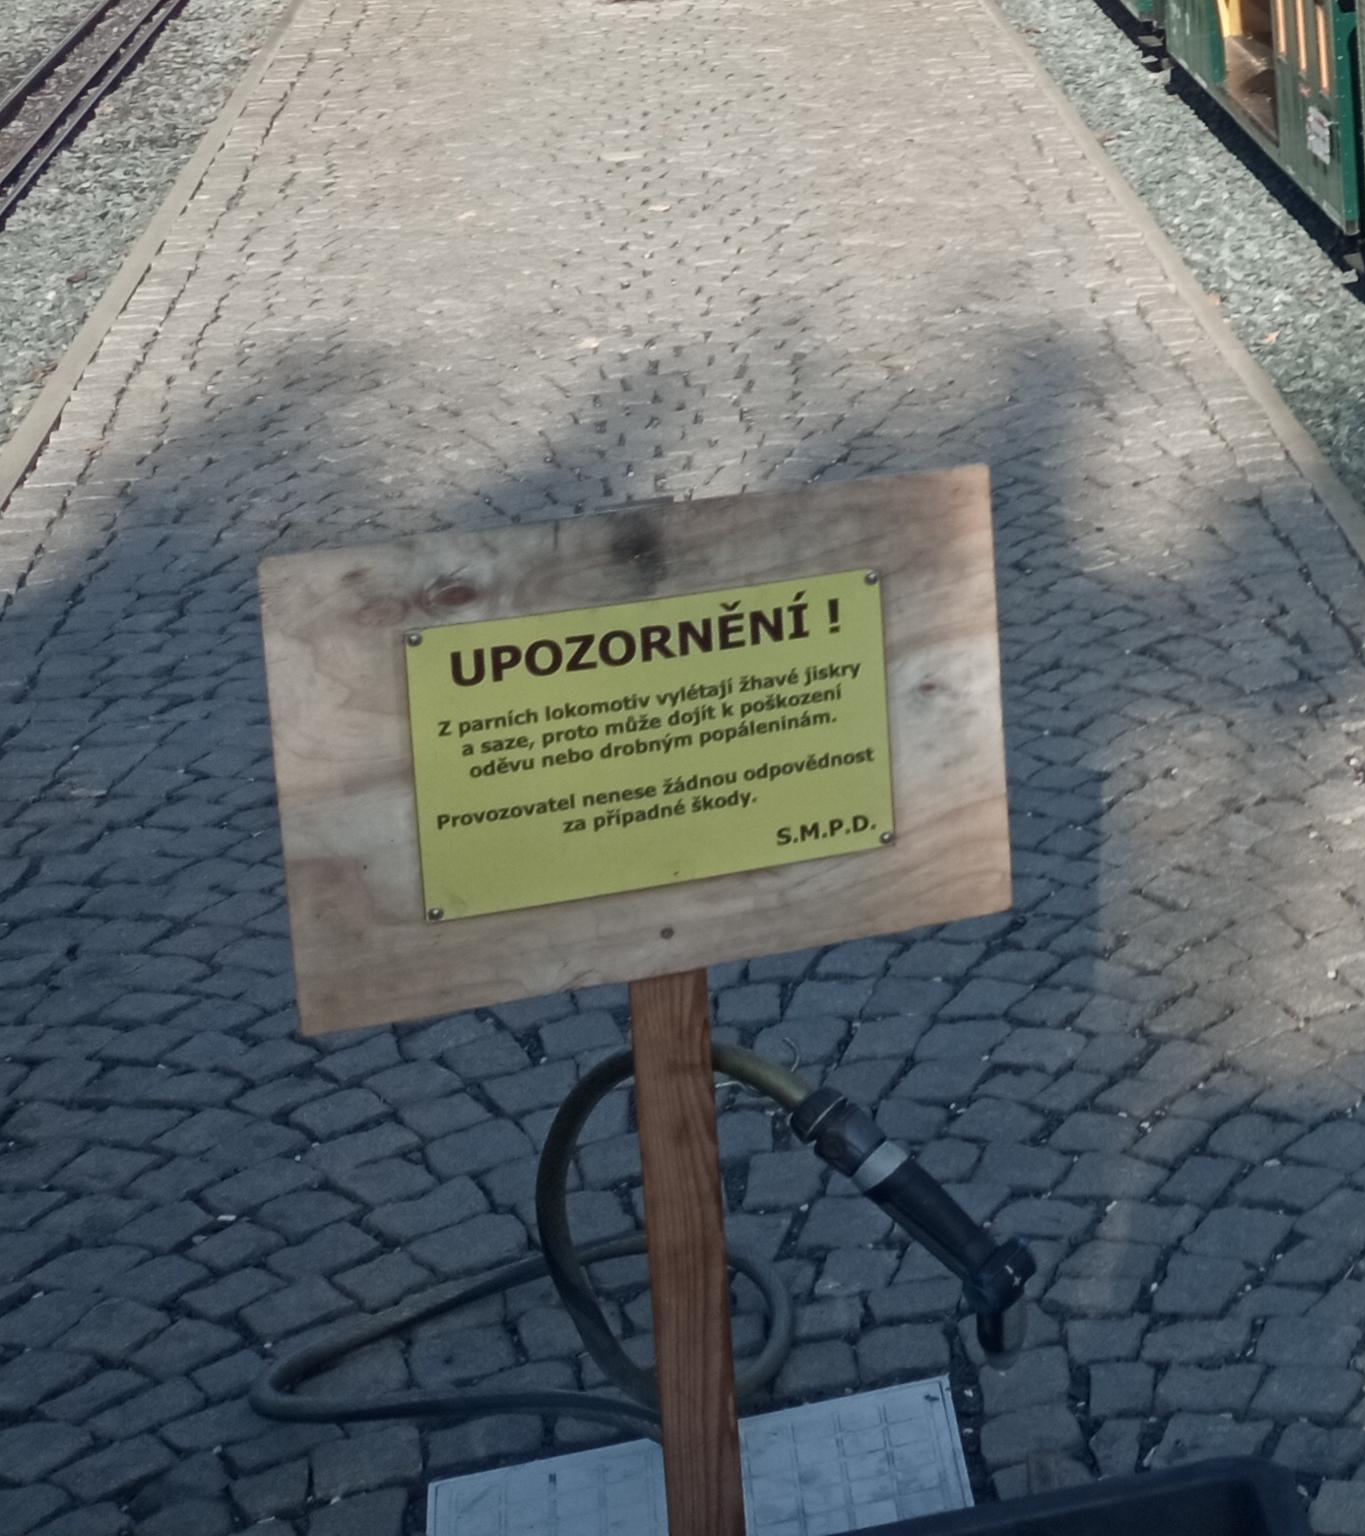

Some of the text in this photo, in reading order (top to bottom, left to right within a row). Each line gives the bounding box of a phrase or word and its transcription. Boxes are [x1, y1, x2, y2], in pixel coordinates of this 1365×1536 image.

[449, 590, 840, 687] UPOZORNĚNÍ !
[437, 662, 860, 738] Z parních lokomotiv vylétají žhavé jiskry
[461, 683, 841, 756] a saze, proto může dojít k poškození
[469, 711, 836, 778] oděvu nebo drobným popáleninám.
[436, 747, 874, 830] Provozovatel nenese žádnou odpovědnost
[562, 790, 757, 833] za případné škody.
[775, 814, 876, 846] S.M.P.D.
